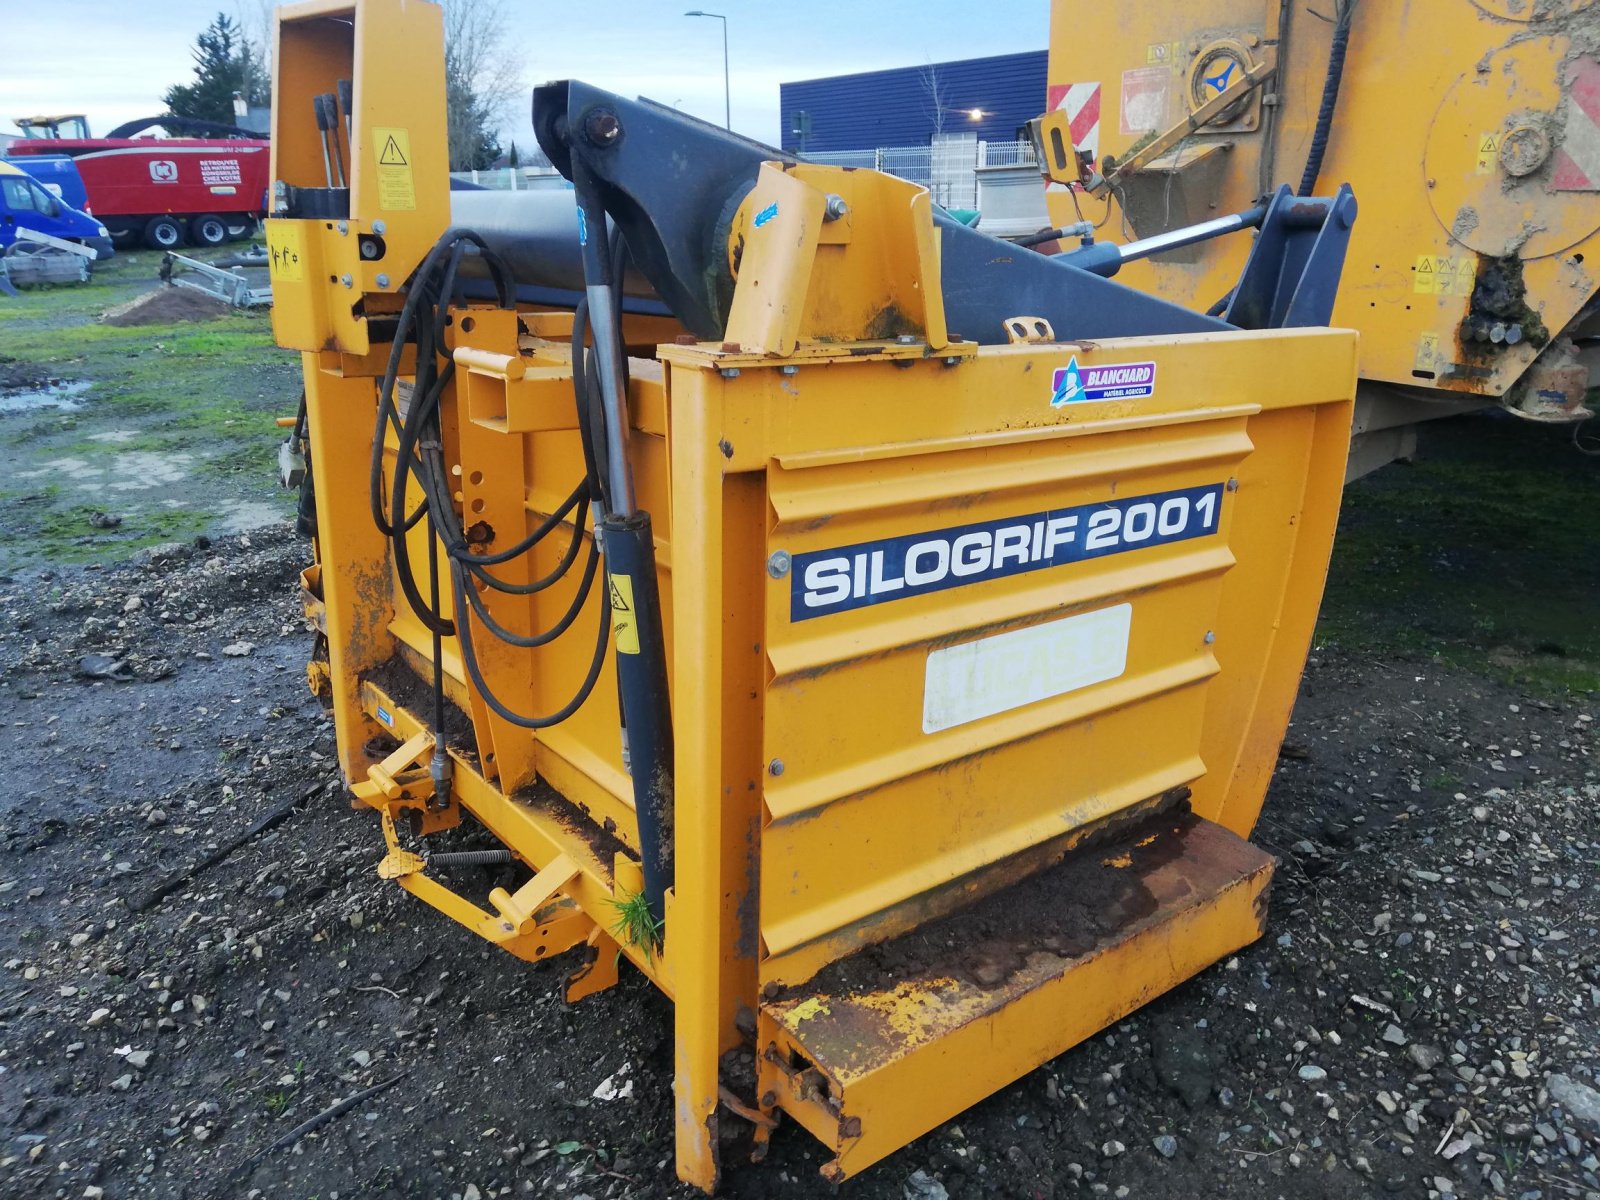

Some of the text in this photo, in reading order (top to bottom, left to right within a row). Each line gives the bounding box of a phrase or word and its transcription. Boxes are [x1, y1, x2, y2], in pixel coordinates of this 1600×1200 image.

[1087, 367, 1151, 386] BLANCHARD
[1125, 387, 1147, 396] AGRICOLE
[804, 492, 1216, 608] SILOGRIF 2001
